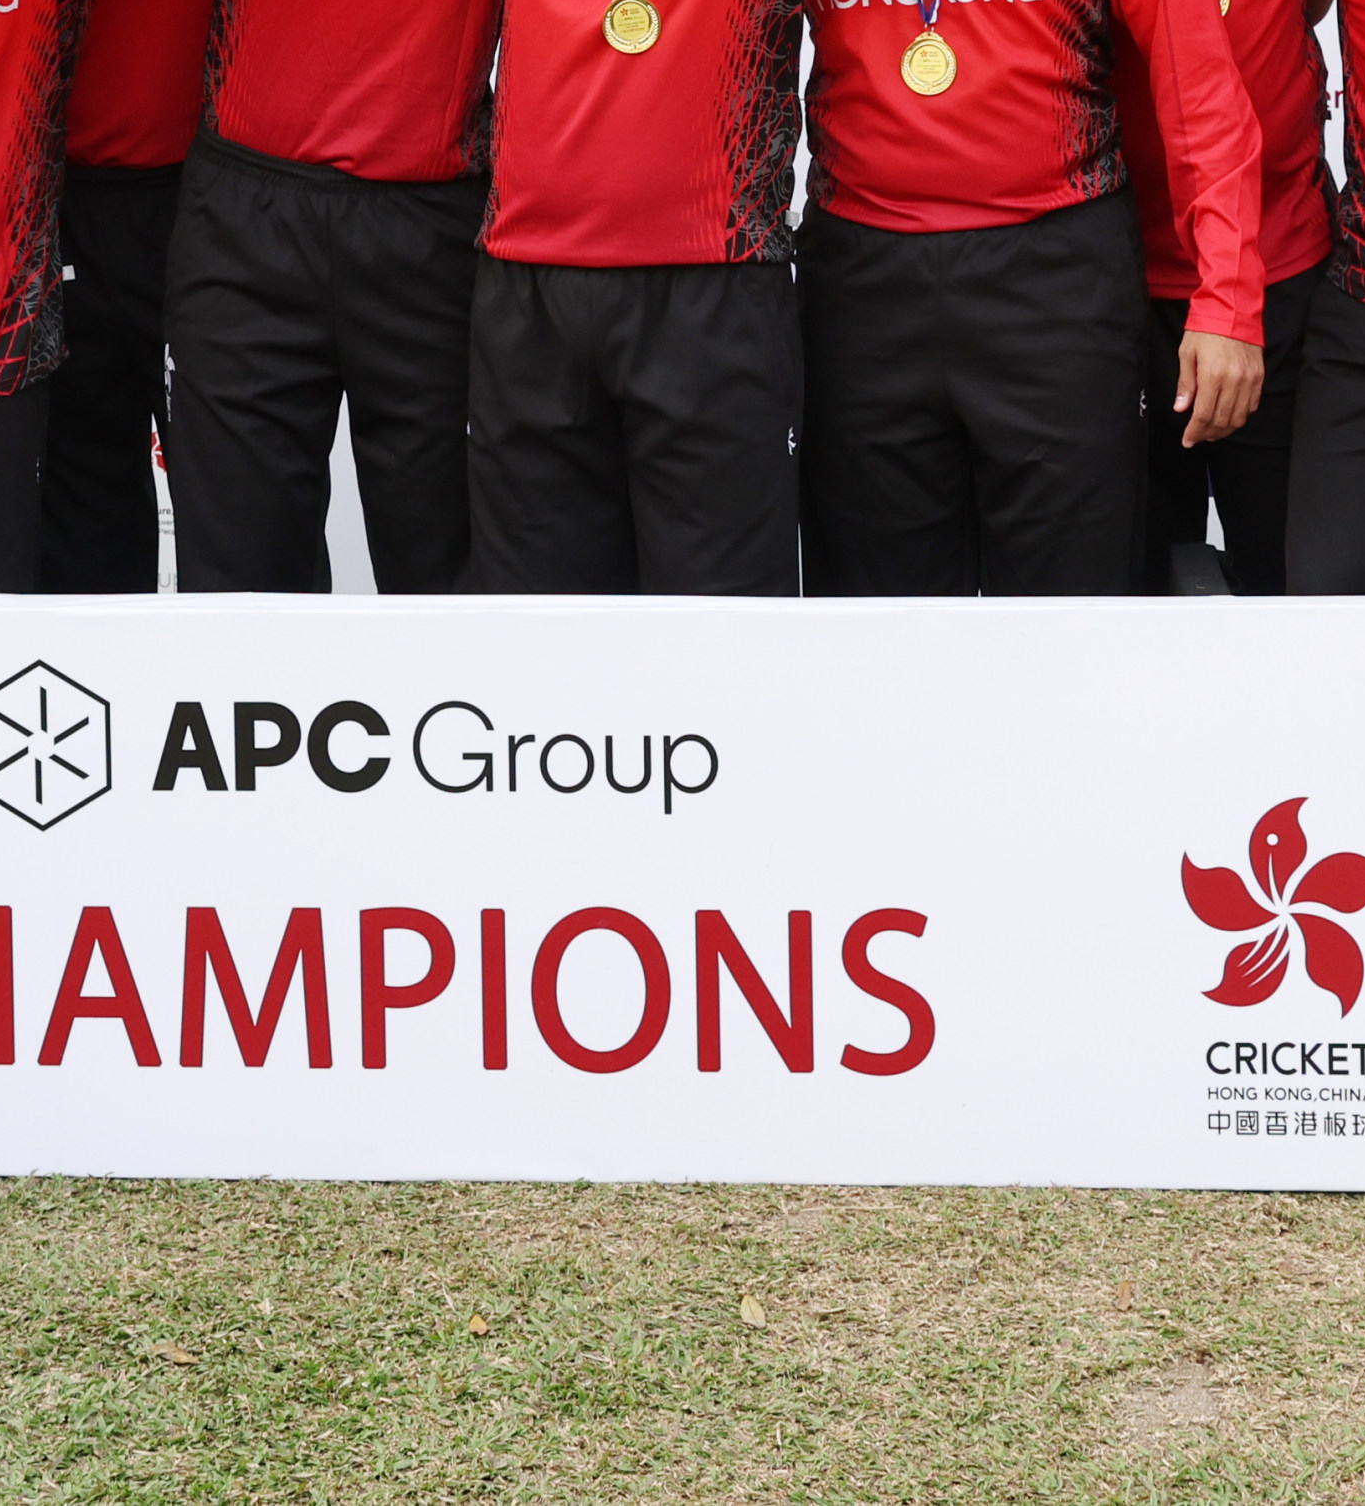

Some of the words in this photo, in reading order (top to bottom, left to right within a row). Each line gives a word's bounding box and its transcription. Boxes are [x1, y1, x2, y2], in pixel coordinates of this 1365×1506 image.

[151, 699, 391, 793] APC
[412, 699, 719, 815] Group
[1207, 1087, 1258, 1100] HONG
